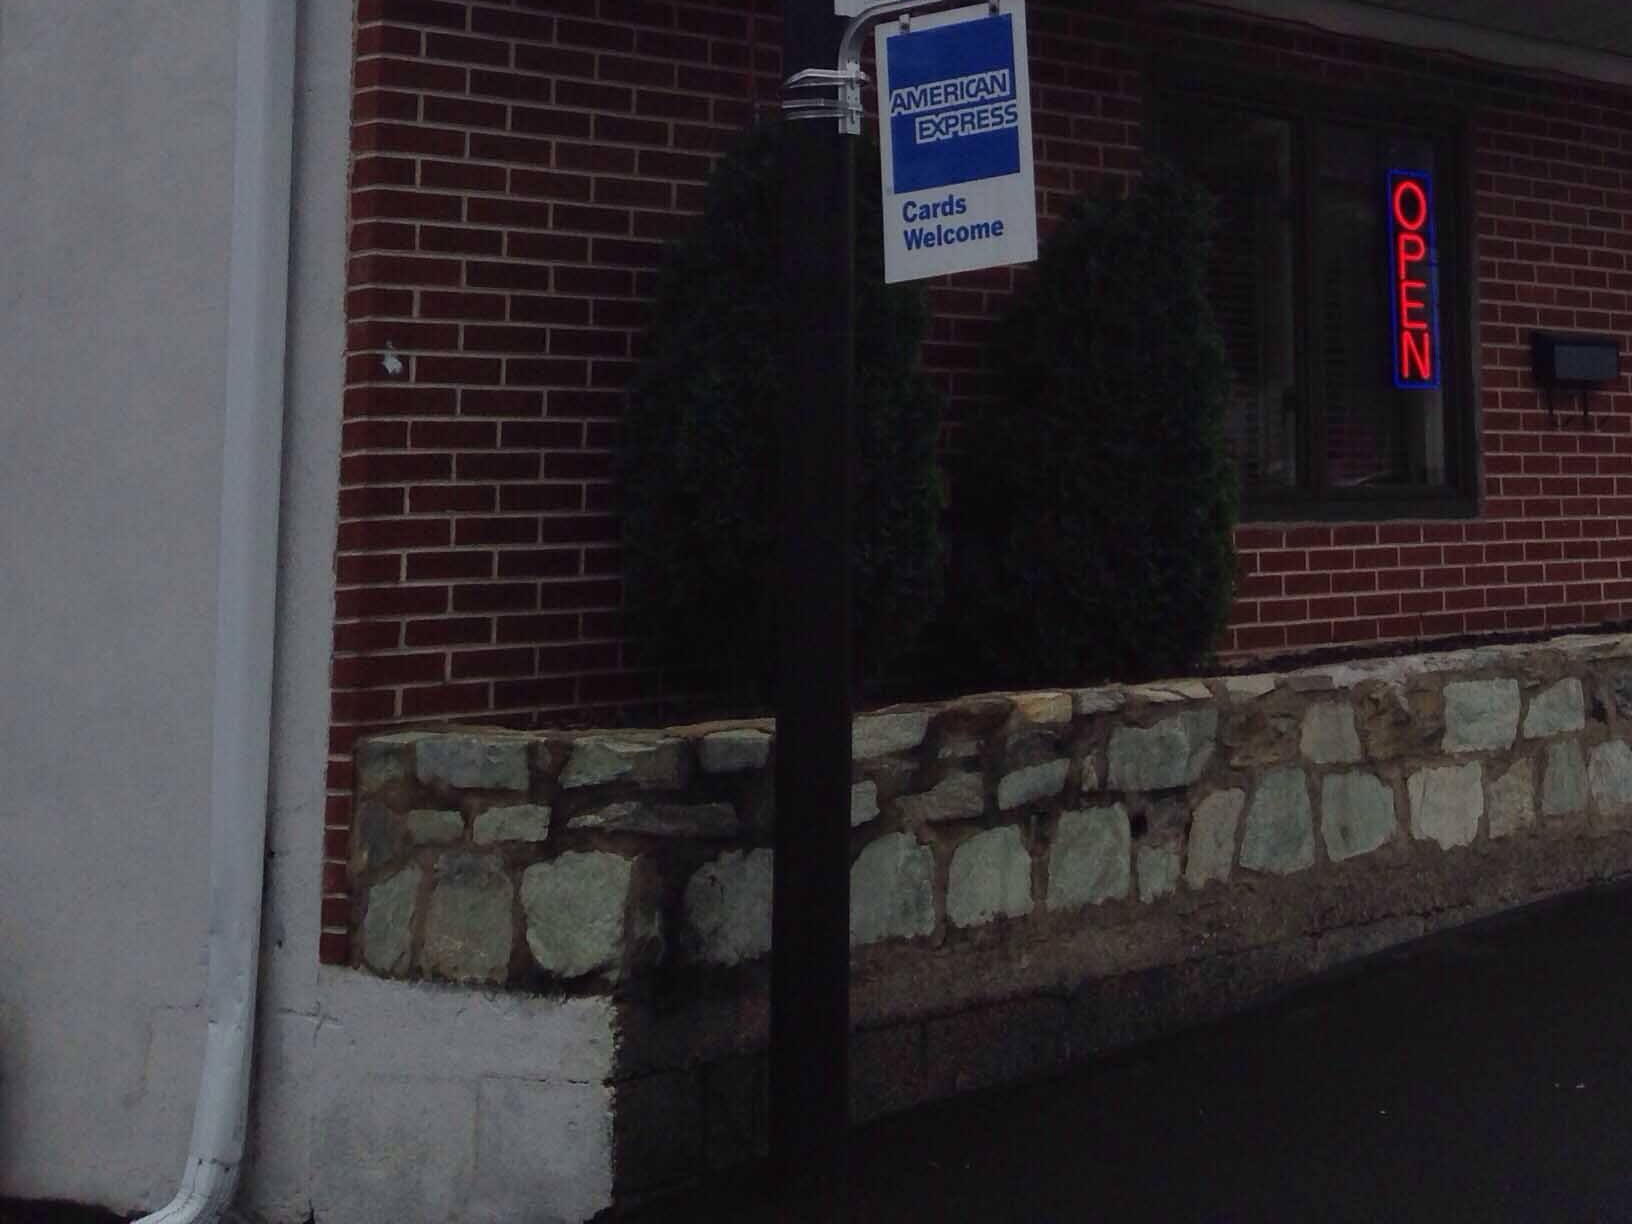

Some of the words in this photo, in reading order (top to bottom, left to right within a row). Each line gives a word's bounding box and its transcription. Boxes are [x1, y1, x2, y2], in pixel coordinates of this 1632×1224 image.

[890, 72, 1010, 114] AMERICAN
[917, 103, 1019, 142] EXPRESS
[902, 193, 968, 223] Cards
[903, 219, 1005, 250] Welcome
[1392, 180, 1431, 380] OPEN
